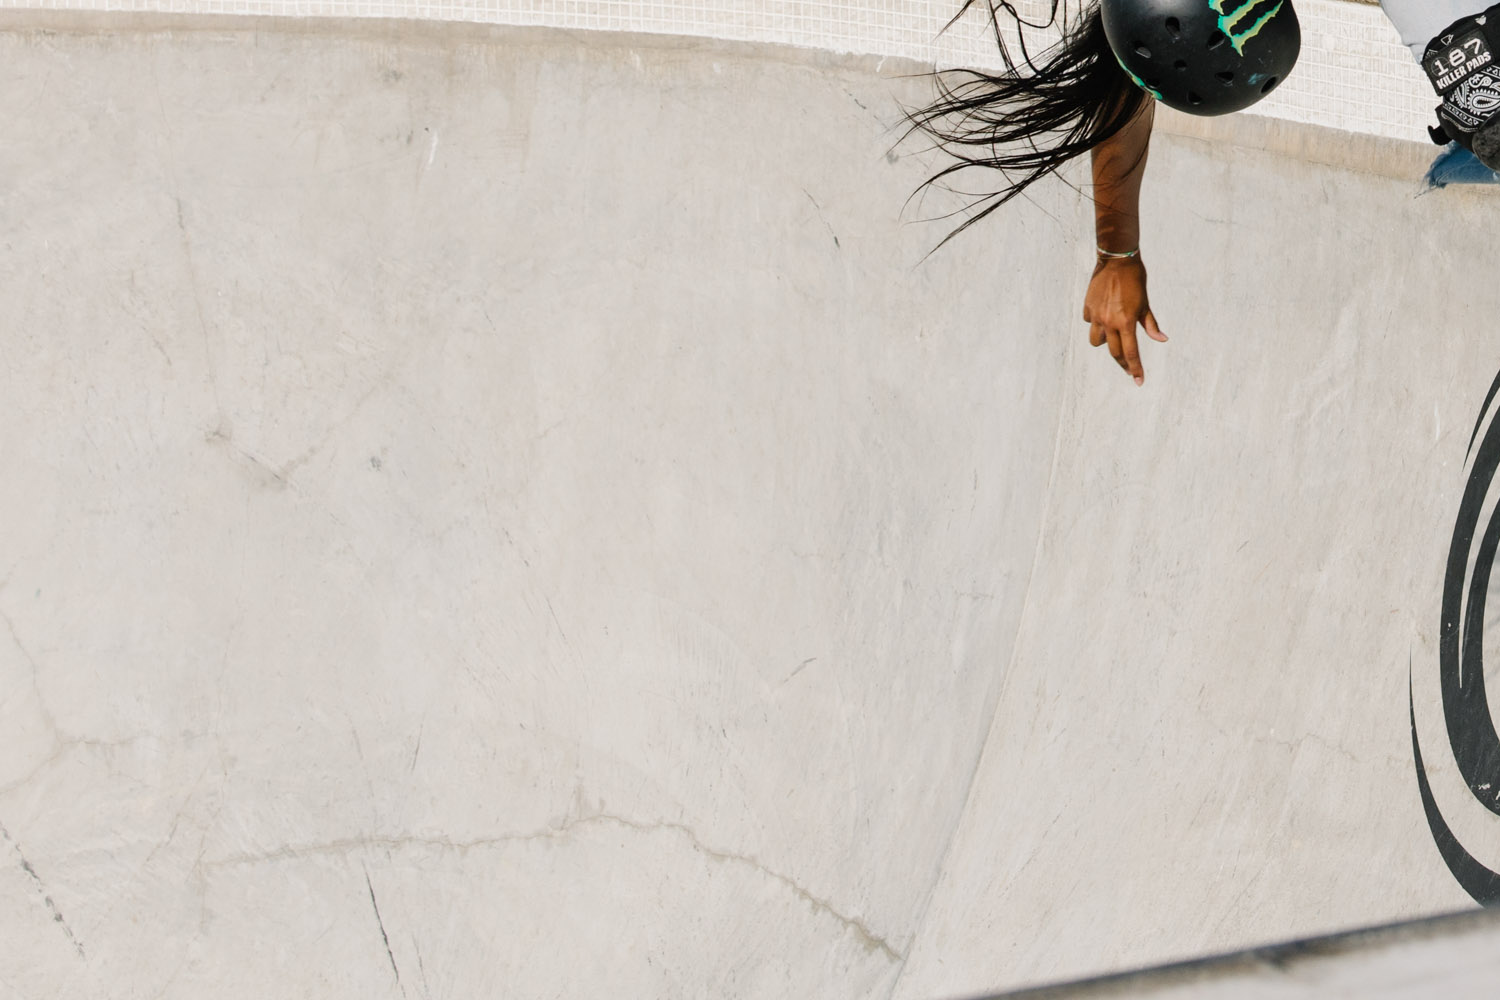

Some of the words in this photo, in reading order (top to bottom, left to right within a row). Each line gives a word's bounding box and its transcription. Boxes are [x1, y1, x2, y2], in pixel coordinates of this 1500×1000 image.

[1434, 38, 1482, 76] 187
[1436, 66, 1468, 90] KILLER
[1465, 51, 1492, 72] PADS
